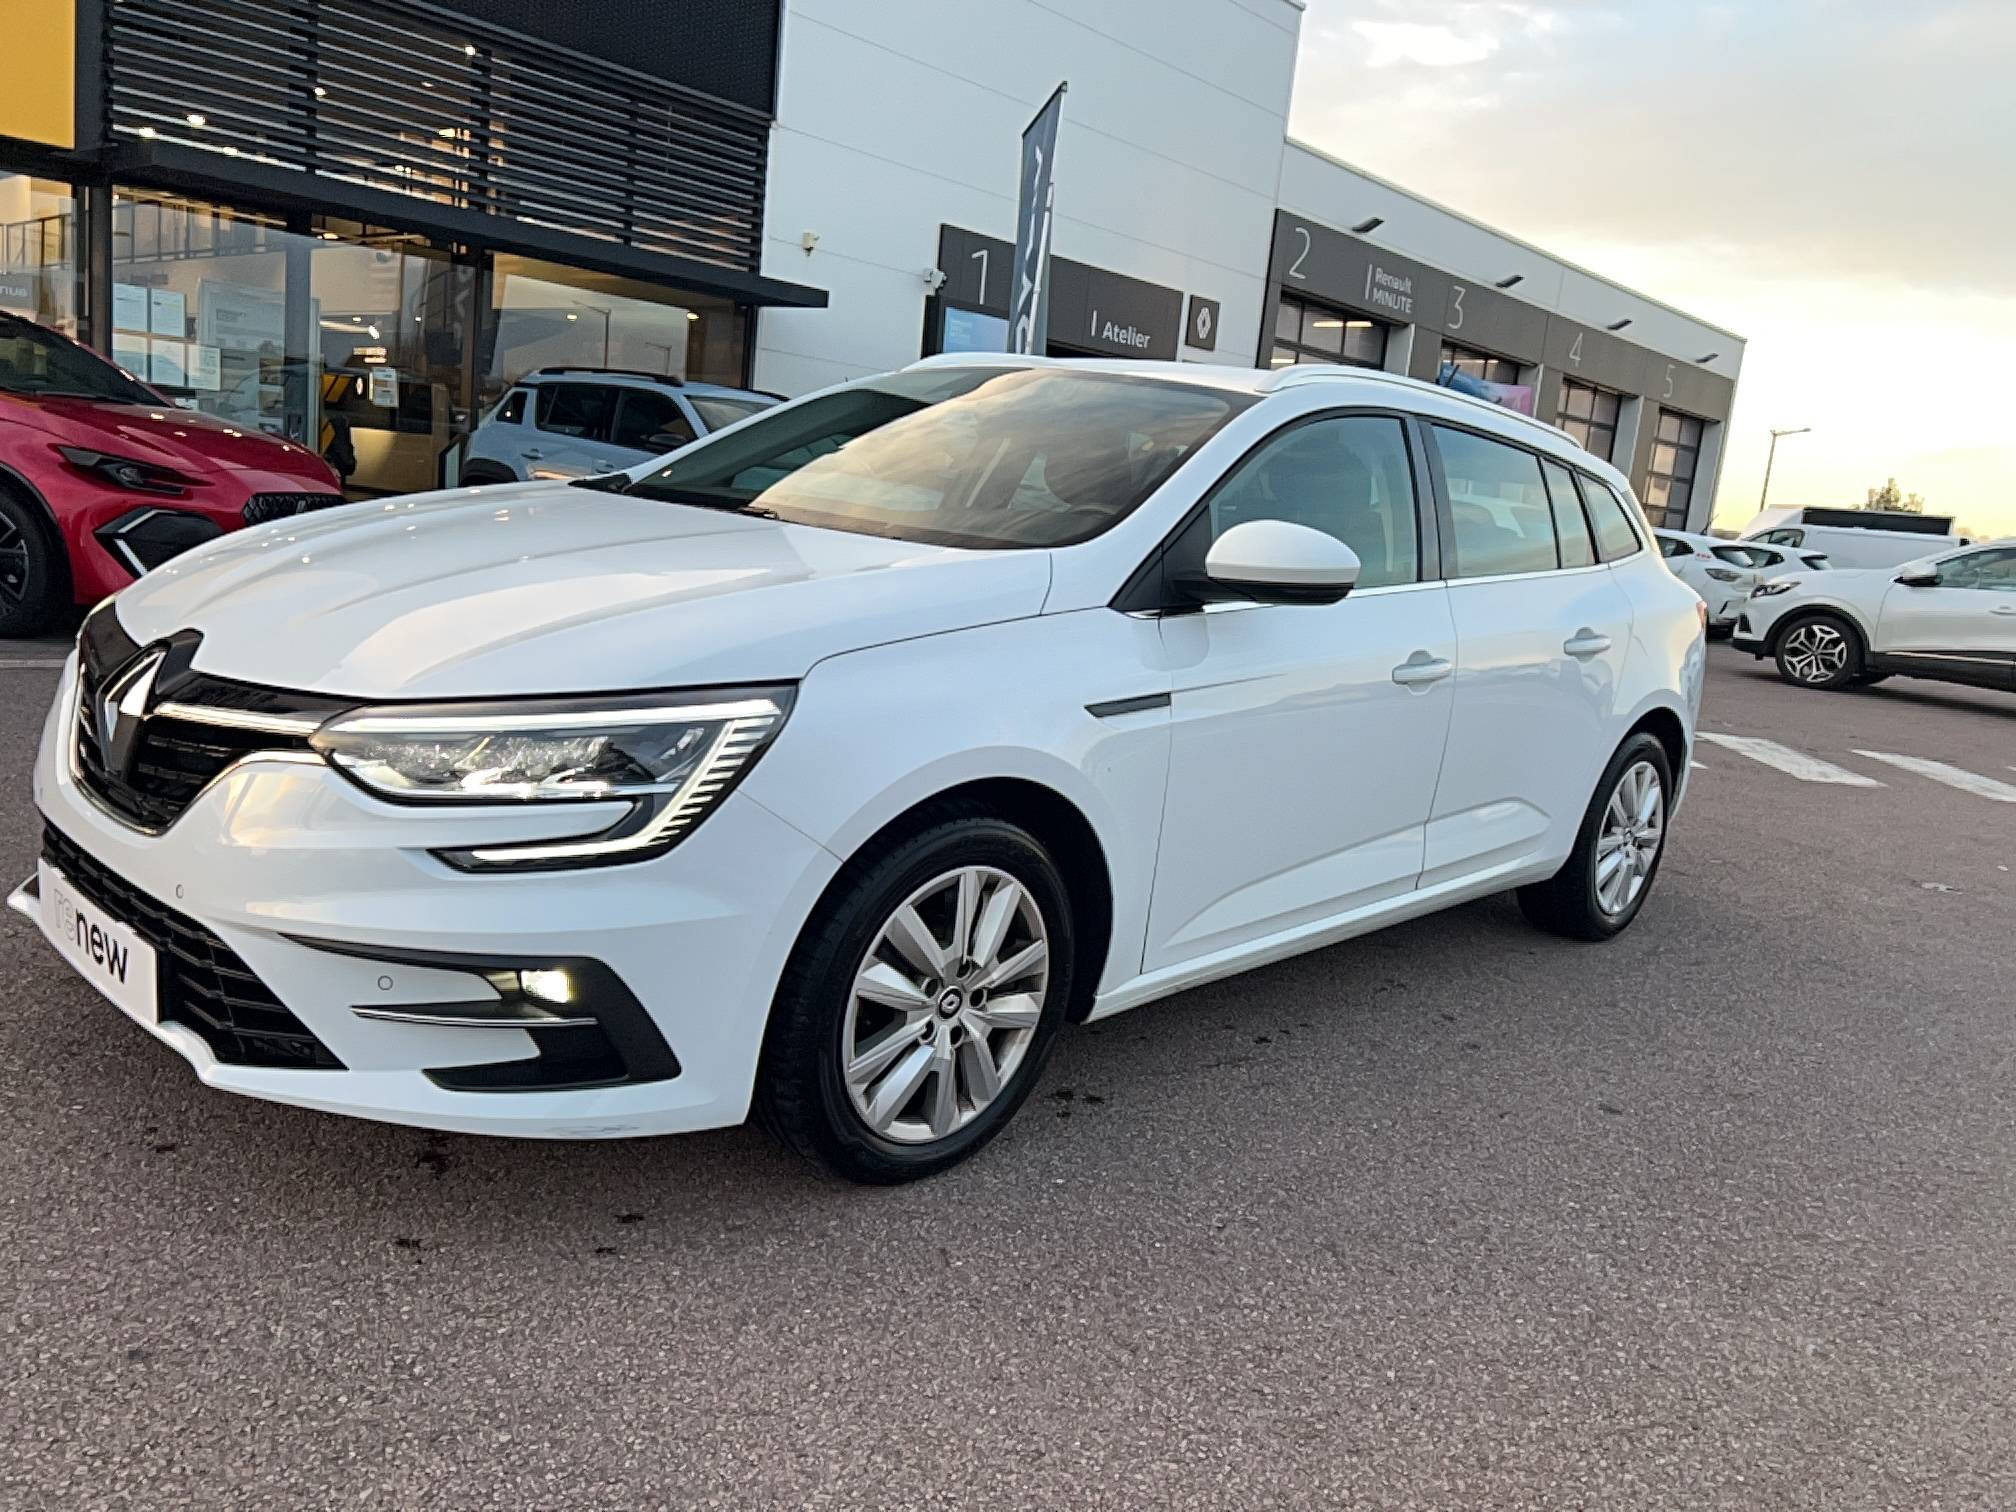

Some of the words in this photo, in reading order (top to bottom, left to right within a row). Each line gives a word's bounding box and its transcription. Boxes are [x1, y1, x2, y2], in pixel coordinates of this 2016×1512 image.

[1288, 227, 1311, 279] 2
[971, 249, 989, 305] 1
[1375, 267, 1412, 294] Renault
[1373, 287, 1413, 313] MINUTE
[1447, 285, 1466, 329] 3
[1101, 320, 1151, 349] Atelier
[1568, 332, 1583, 367] 4
[1663, 364, 1674, 398] 5
